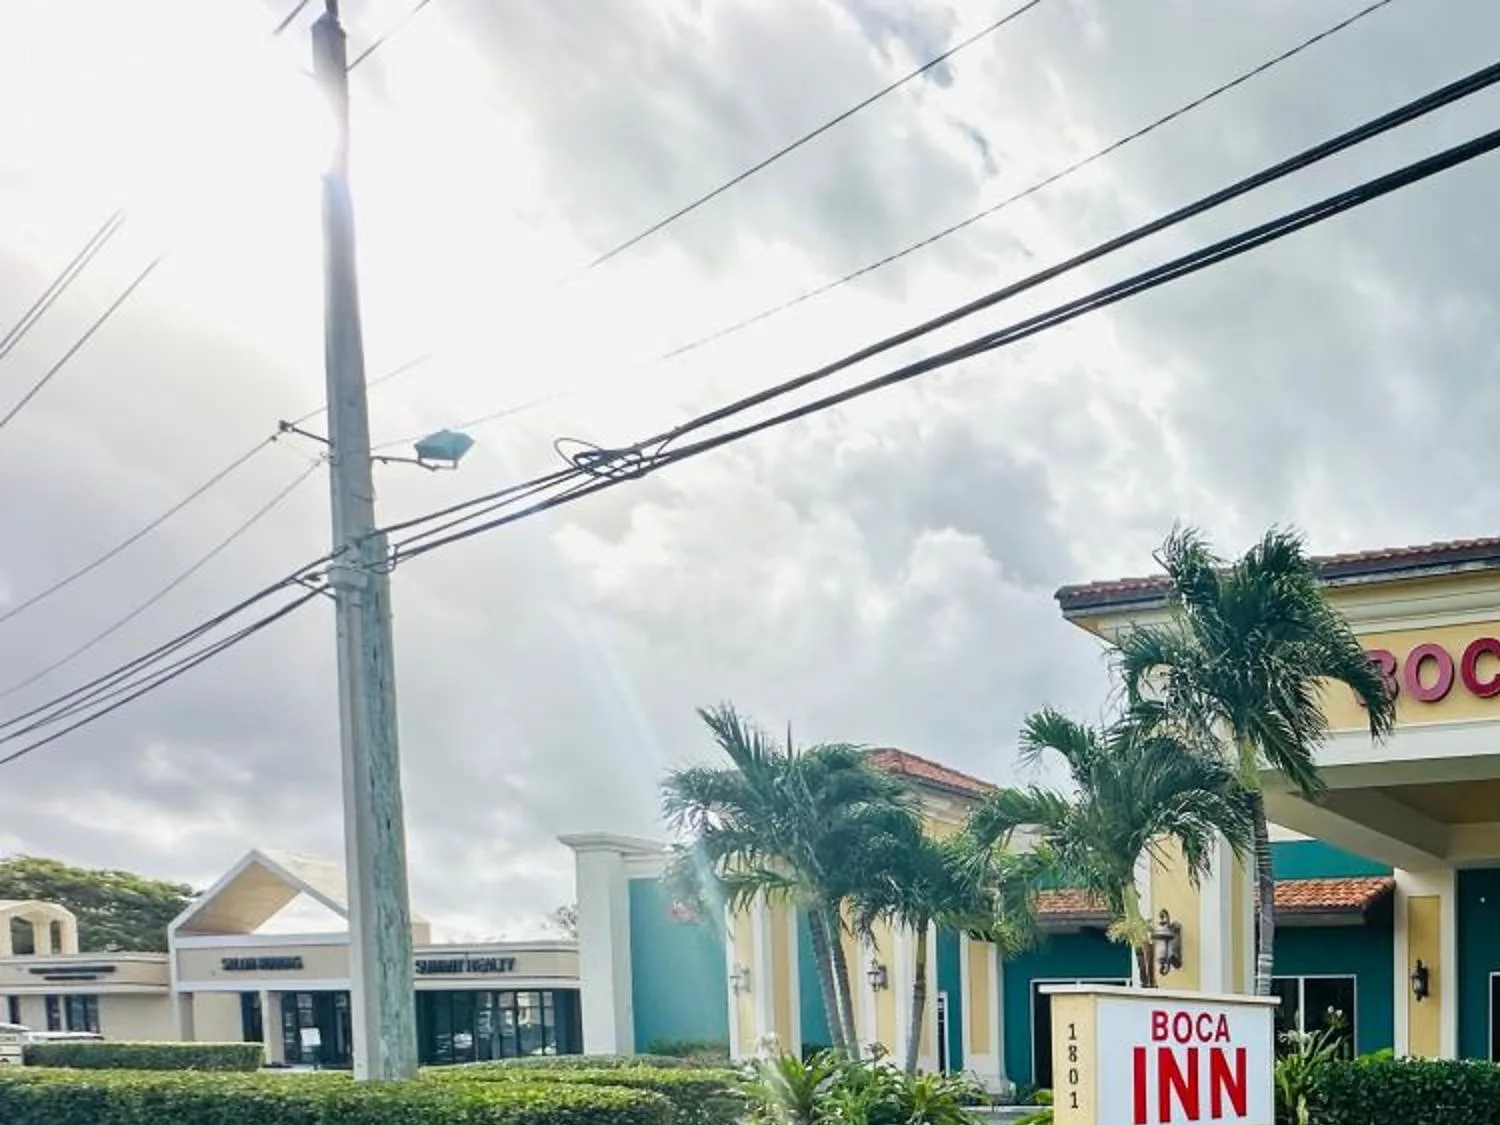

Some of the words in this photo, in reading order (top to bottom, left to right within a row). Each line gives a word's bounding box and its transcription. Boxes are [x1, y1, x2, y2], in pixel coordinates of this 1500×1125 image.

[1067, 1023, 1079, 1109] 1801
[1151, 1010, 1231, 1043] BOCA
[1133, 1046, 1247, 1125] INN
